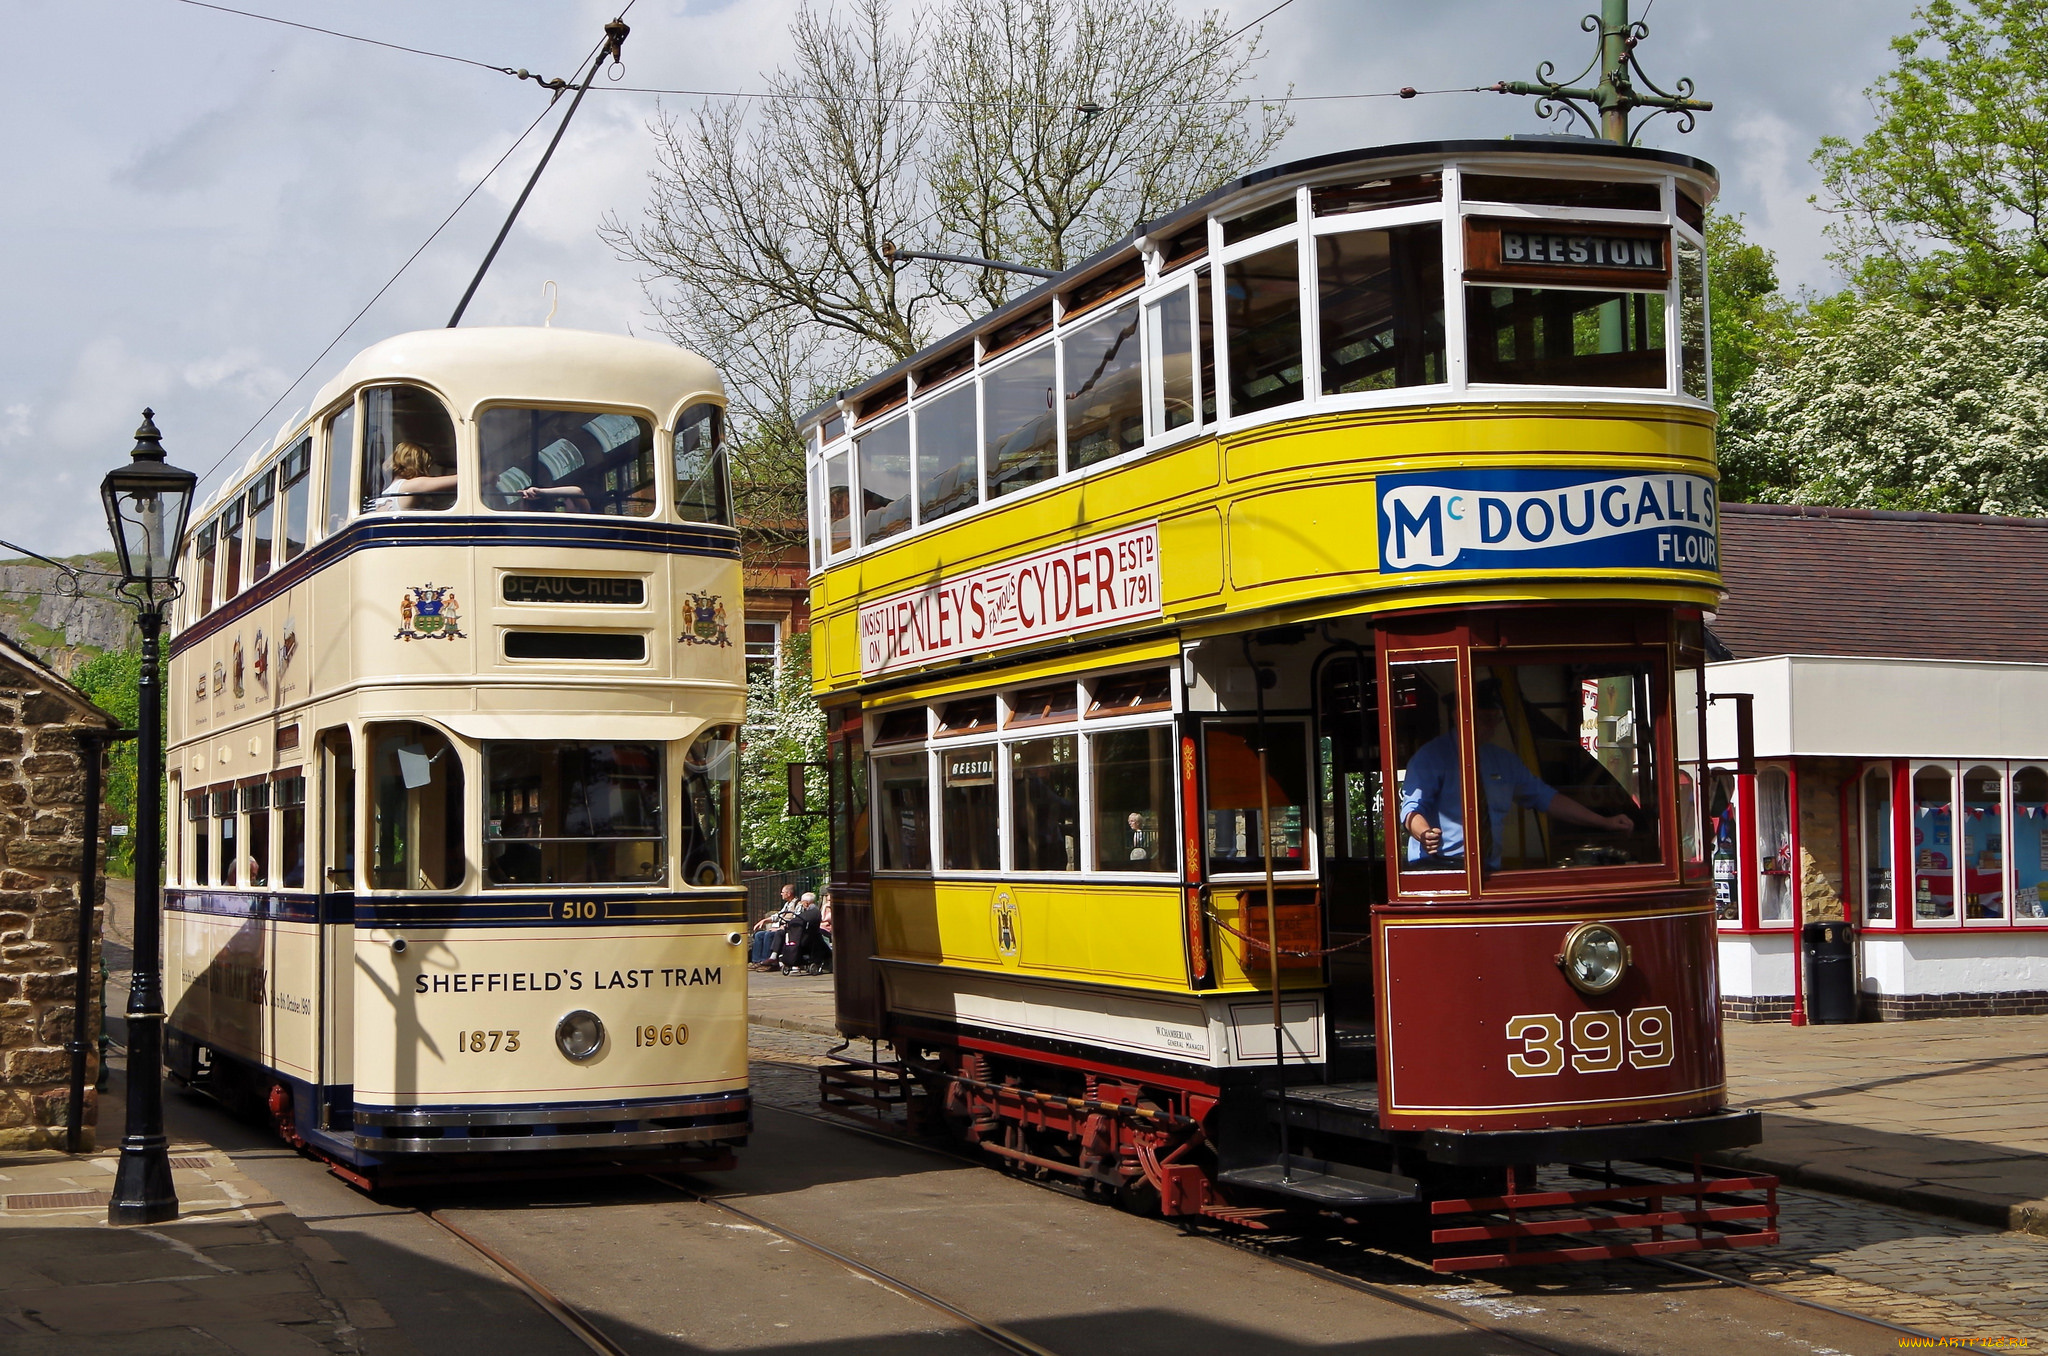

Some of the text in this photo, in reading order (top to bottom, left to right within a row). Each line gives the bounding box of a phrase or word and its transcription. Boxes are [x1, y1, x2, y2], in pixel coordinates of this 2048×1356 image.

[1504, 234, 1654, 266] BEESTON
[1658, 534, 1717, 565] FLOUR
[886, 547, 1118, 659] HENLEY'S FAMOUS CYDER
[1123, 573, 1153, 608] 1791
[861, 609, 885, 638] INSIST
[869, 640, 881, 663] ON
[561, 902, 597, 919] 510
[415, 967, 722, 994] SHEFFIELD'S LAST TRAM
[459, 1023, 690, 1053] 1873 1960
[1186, 1042, 1204, 1051] MANAGER
[1505, 1005, 1675, 1078] 399
